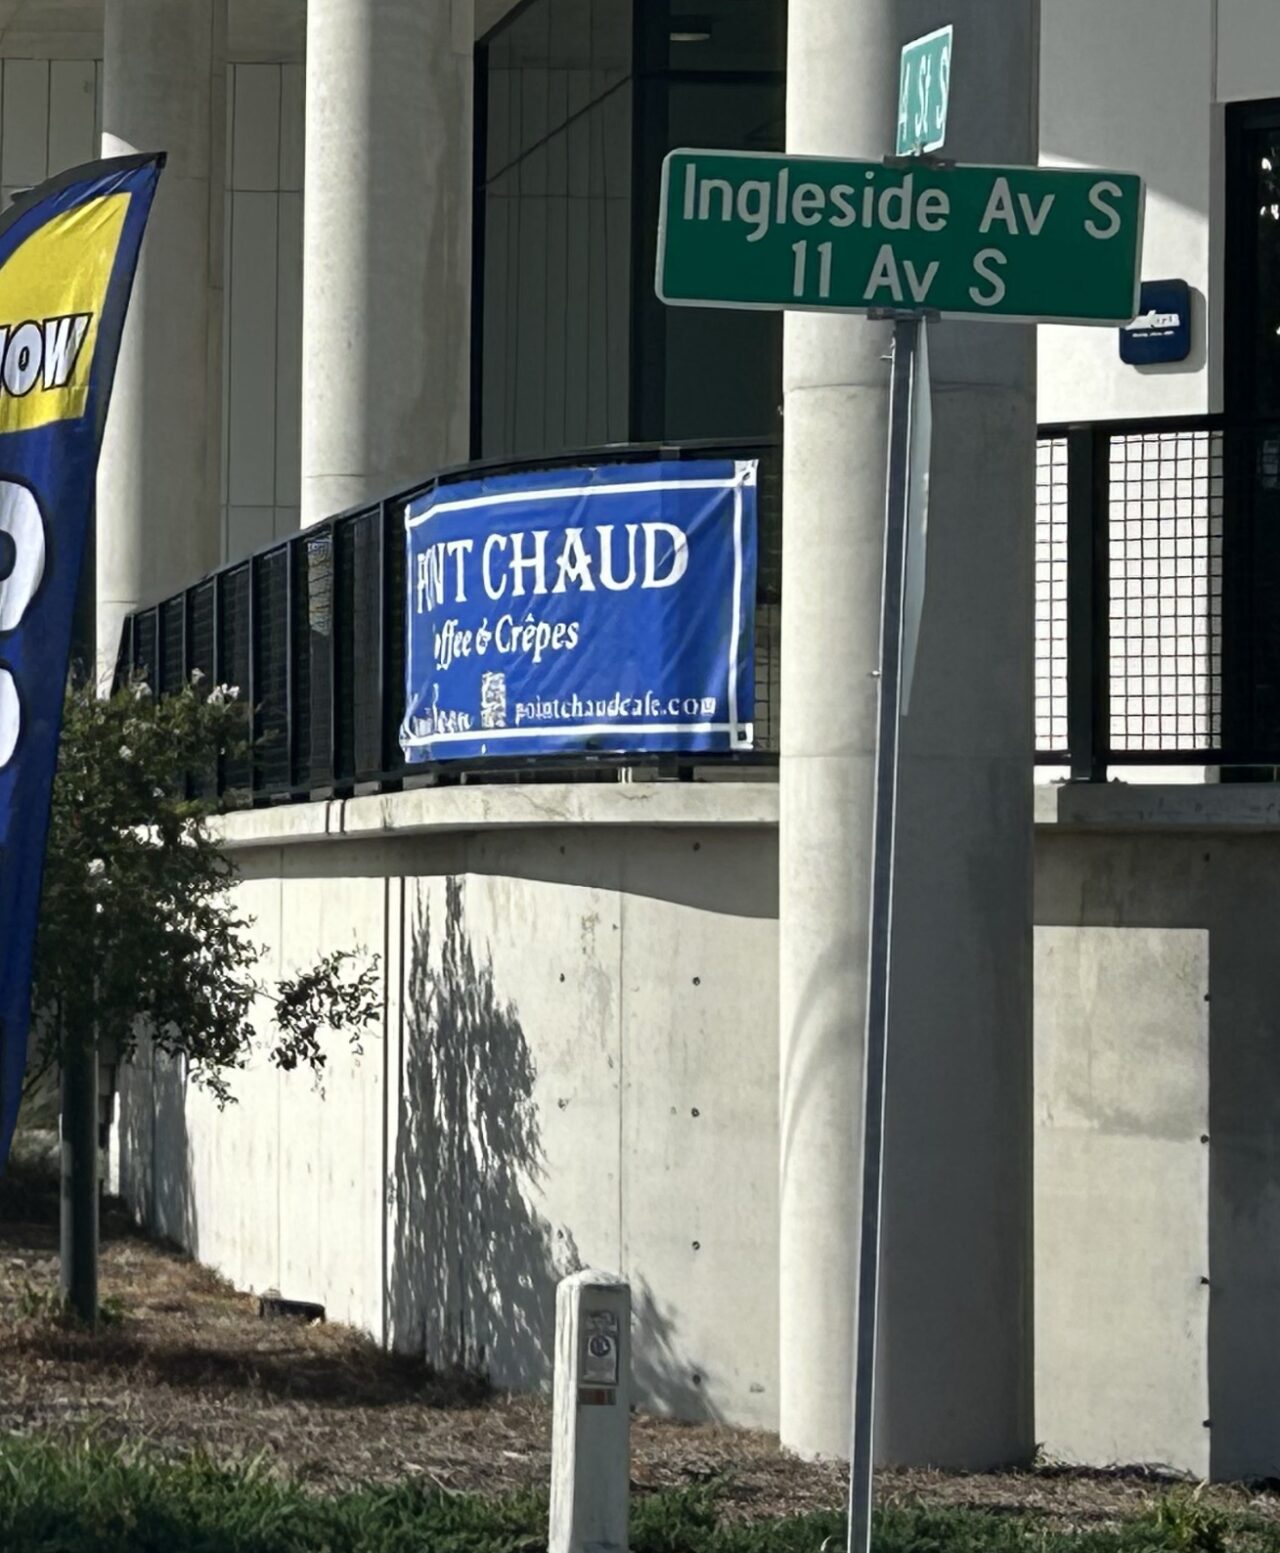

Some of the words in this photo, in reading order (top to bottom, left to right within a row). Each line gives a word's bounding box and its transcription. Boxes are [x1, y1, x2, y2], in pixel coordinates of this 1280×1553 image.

[915, 53, 931, 138] St
[936, 45, 949, 130] S
[683, 163, 950, 242] Ingleside
[979, 177, 1055, 236] Av
[1084, 181, 1123, 240] S
[792, 240, 833, 298] 11
[863, 244, 939, 302] Av
[969, 248, 1008, 307] S
[482, 522, 689, 601] CHAUD
[495, 613, 580, 664] Crêpes
